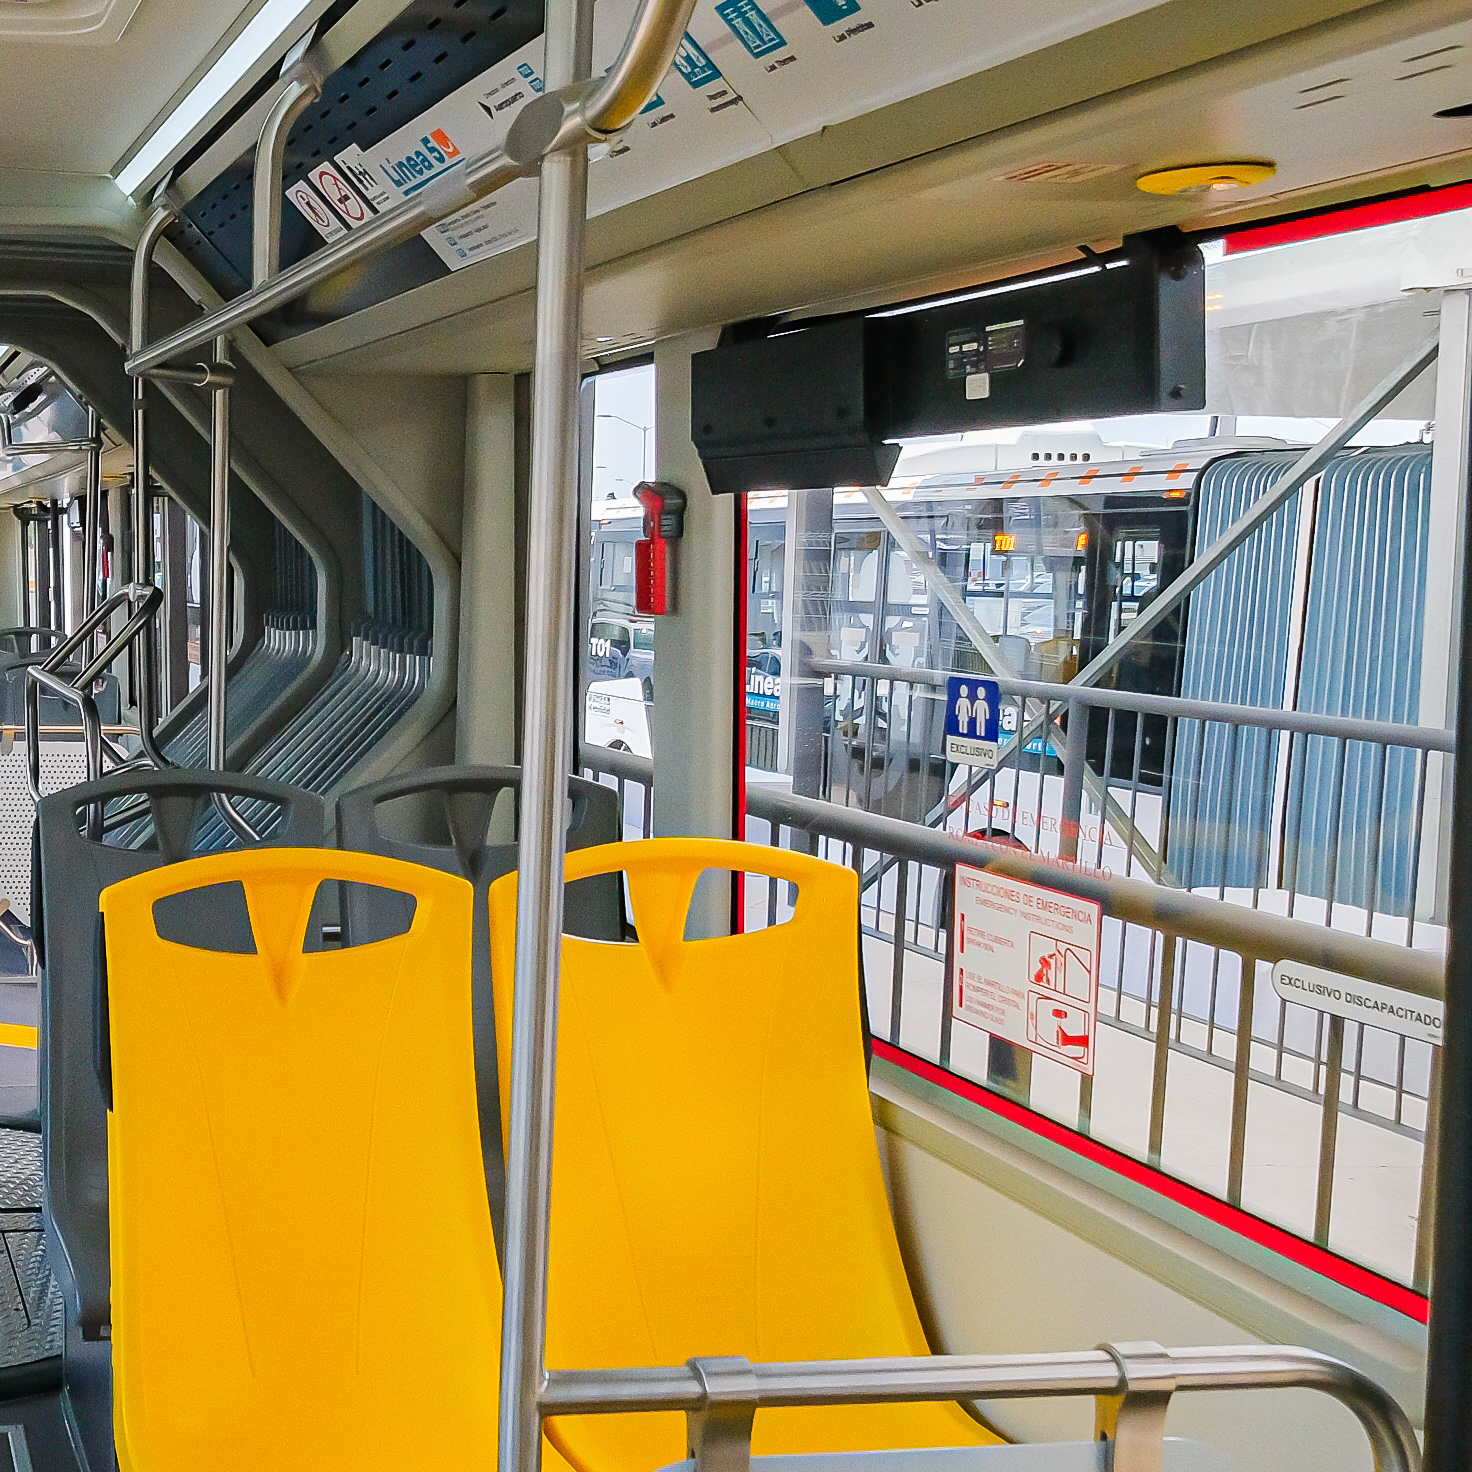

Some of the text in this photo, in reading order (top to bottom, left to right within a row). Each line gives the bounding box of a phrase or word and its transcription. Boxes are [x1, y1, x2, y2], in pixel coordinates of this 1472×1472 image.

[379, 135, 446, 188] Línea 5
[589, 638, 611, 658] T01
[950, 742, 994, 759] EXCLUSIVO
[959, 875, 1020, 905] INSTRUCCIONES
[1036, 897, 1093, 925] EMERGENCIA
[1280, 974, 1442, 1029] EXCLUSIVO DISCAPACITADO
